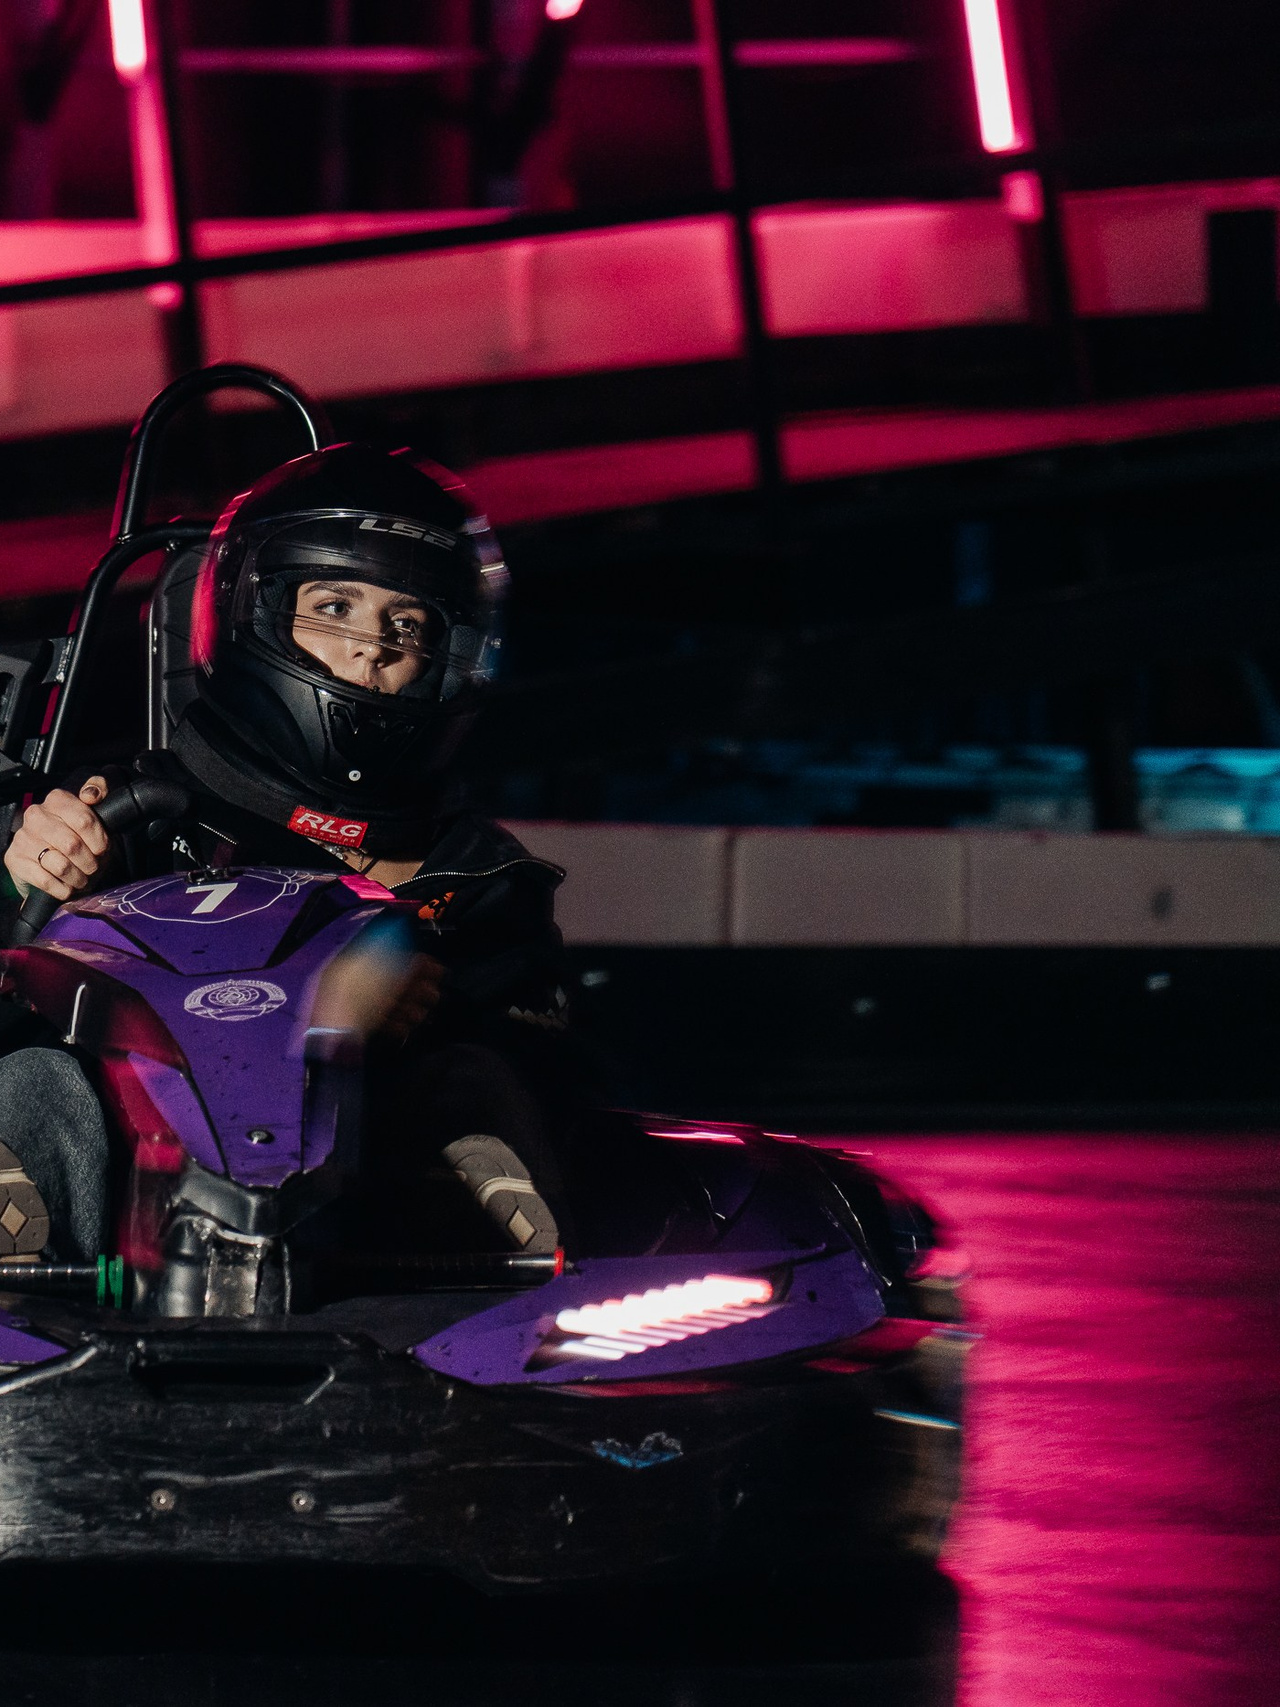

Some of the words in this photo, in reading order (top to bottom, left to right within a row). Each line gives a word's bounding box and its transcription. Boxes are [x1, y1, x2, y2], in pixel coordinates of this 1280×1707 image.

[359, 519, 456, 551] LS2
[297, 812, 362, 837] RLG
[185, 882, 238, 914] 7
